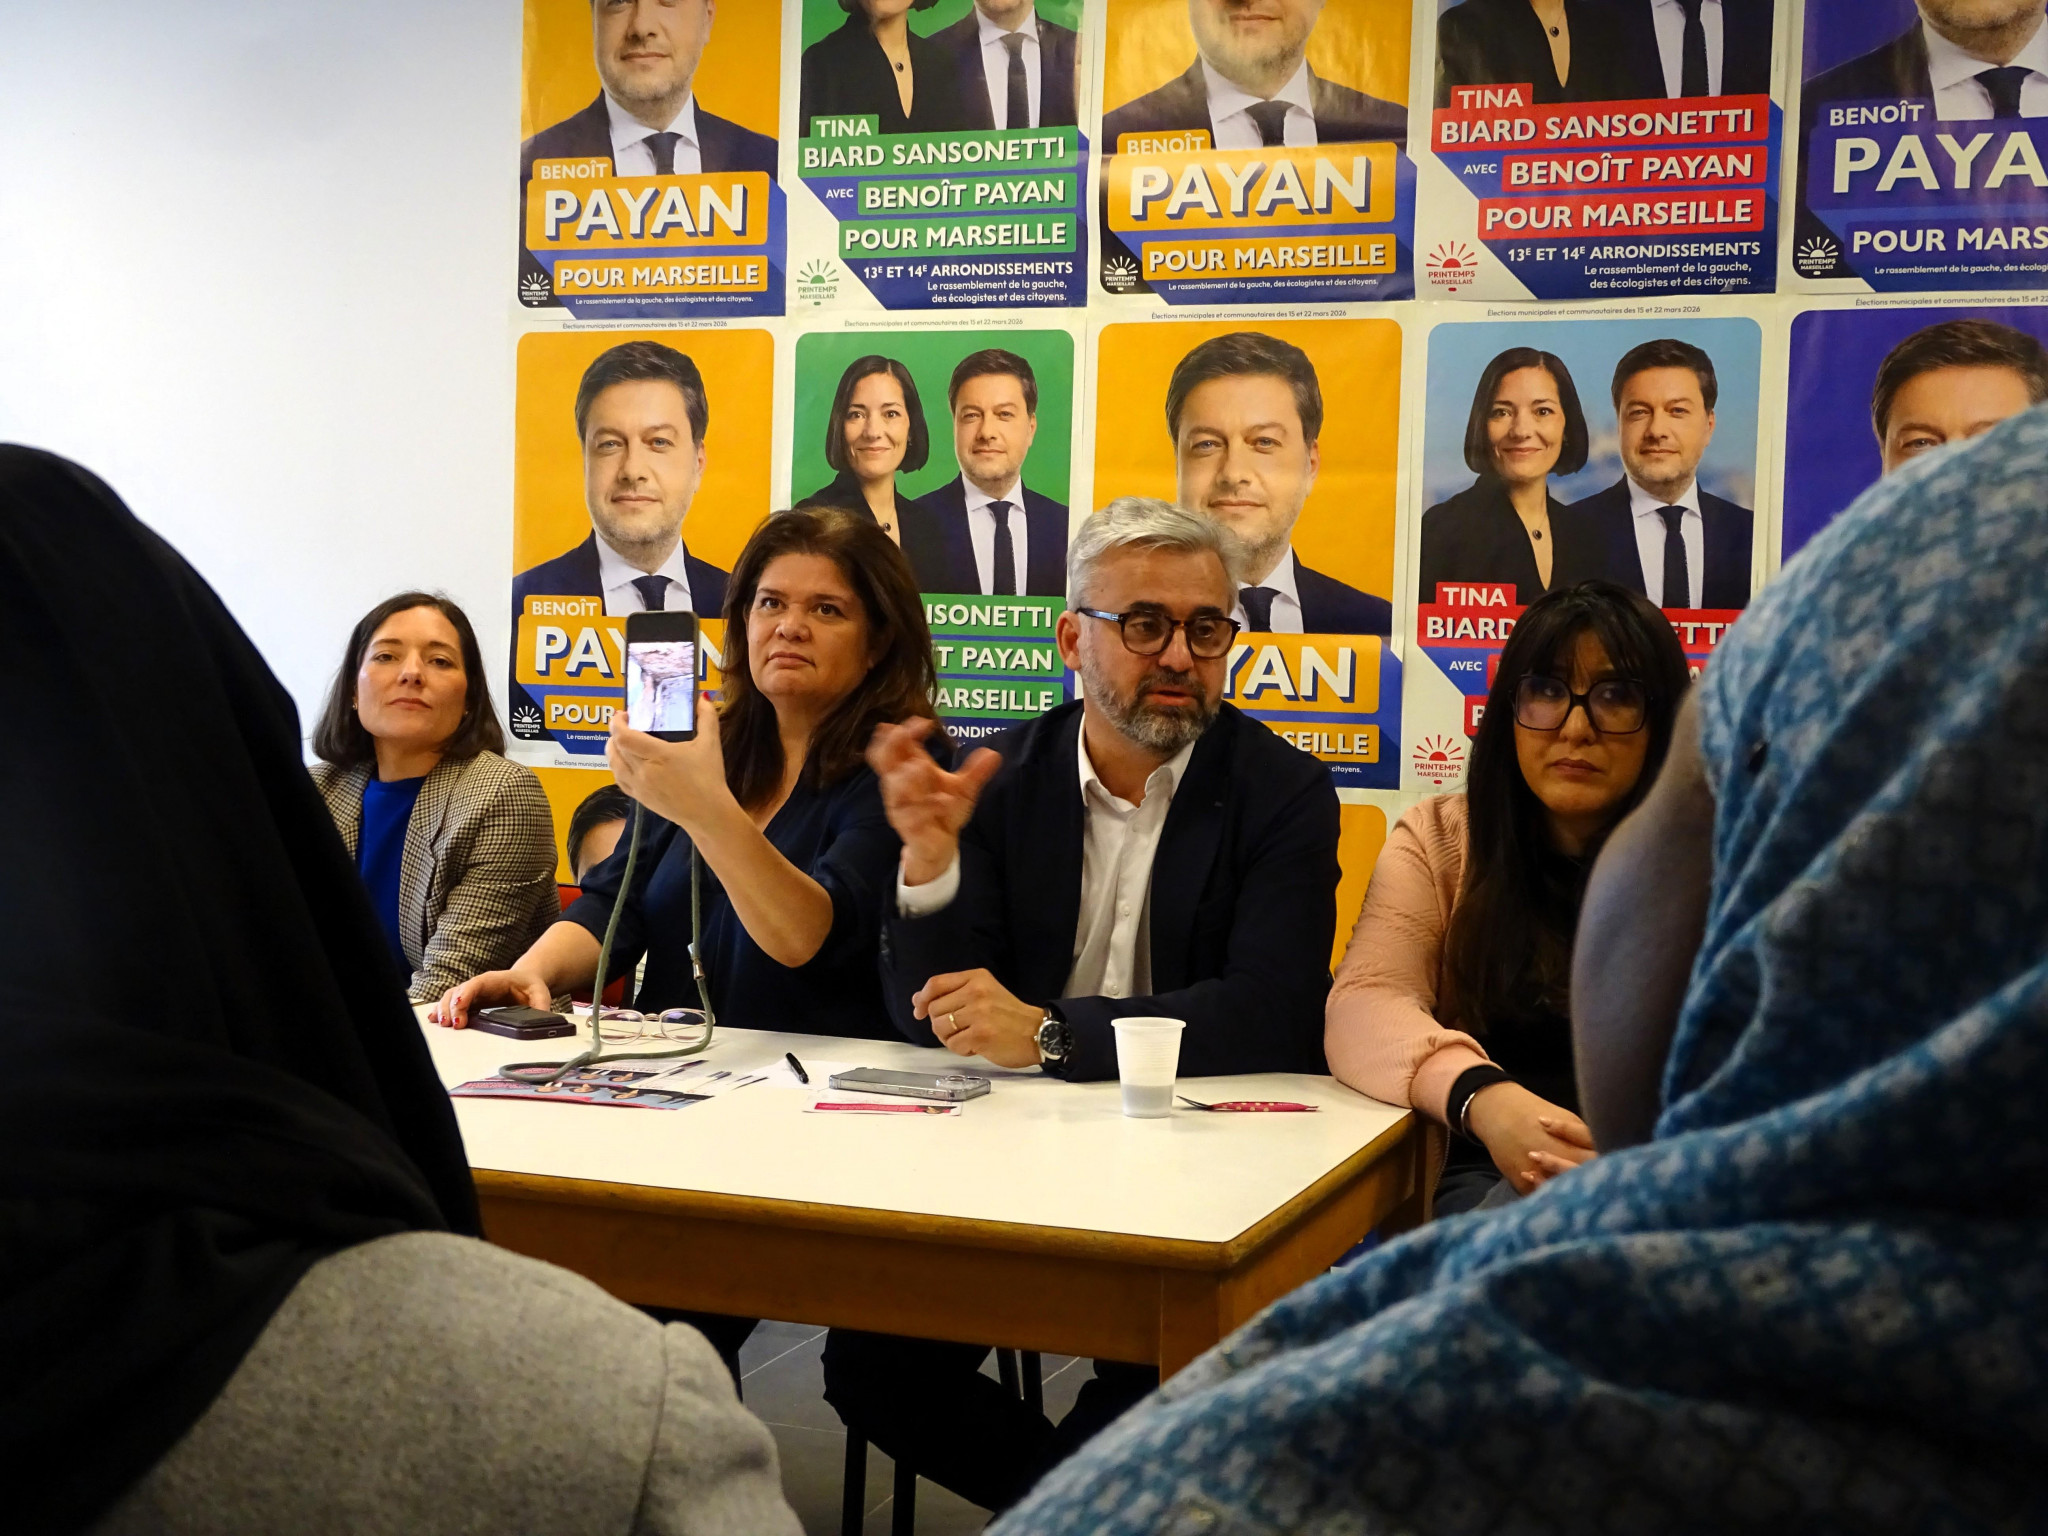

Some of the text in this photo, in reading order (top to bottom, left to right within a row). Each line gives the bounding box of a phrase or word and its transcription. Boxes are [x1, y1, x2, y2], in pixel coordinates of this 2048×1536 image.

[1458, 88, 1524, 110] TINA
[1830, 100, 1924, 126] BENOÎT
[816, 118, 872, 138] TINA
[1441, 109, 1753, 144] BIARD SANSONETTI
[804, 137, 1065, 168] BIARD SANSONETTI
[1126, 133, 1205, 155] BENOÎT
[540, 160, 608, 180] BENOÎT
[1464, 153, 1753, 186] AVEC BENOÎT PAYAN
[1833, 131, 2048, 194] PAYA
[826, 179, 1065, 209] AVEC BENOÎT PAYAN
[1130, 156, 1369, 218] PAYAN
[545, 184, 746, 239] PAYAN
[1486, 199, 1753, 230] POUR MARSEILLE
[845, 223, 1066, 250] POUR MARSEILLE
[1853, 226, 2048, 254] POUR MARS
[1150, 244, 1386, 272] POUR MARSEILLE
[1536, 248, 1556, 261] ET
[1590, 242, 1760, 260] ARRONDISSEMENTS
[560, 264, 760, 288] POUR MARSEILLE
[886, 265, 904, 278] ET
[930, 262, 1073, 277] ARRONDISSEMENTS
[1585, 262, 1752, 275] Le rassemblement de la gauche,
[1886, 266, 1948, 274] rassemblement
[1949, 265, 1959, 273] de
[1960, 265, 1968, 273] la
[1970, 265, 2002, 274] gauche,
[2004, 264, 2018, 272] des
[928, 279, 1067, 291] Le rassemblement de la gauche,
[1178, 282, 1228, 290] rassemblement
[1247, 281, 1272, 290] gauche,
[1286, 279, 1324, 288] écologistes
[1347, 278, 1378, 287] citoyens.
[1589, 276, 1751, 290] des écologistes et des citoyens.
[641, 297, 663, 305] gauche,
[674, 296, 708, 305] écologistes
[727, 296, 753, 304] citoyens.
[931, 291, 1067, 305] des écologistes et des citoyens.
[1855, 298, 1888, 306] Élections
[1151, 312, 1178, 320] Élections
[1517, 309, 1557, 317] municipales
[532, 598, 598, 616] BENOÎT
[1442, 587, 1508, 607] TINA
[926, 604, 1052, 628] SONETTI
[1426, 616, 1516, 639] BIARD
[962, 647, 1052, 670] PAYAN
[1449, 661, 1482, 671] AVEC
[1224, 644, 1352, 698] YAN
[932, 688, 1053, 711] ARSEILLE
[1281, 731, 1368, 754] SEILLE
[1331, 765, 1362, 774] citoyens.
[1414, 763, 1462, 772] PRINTEMPS
